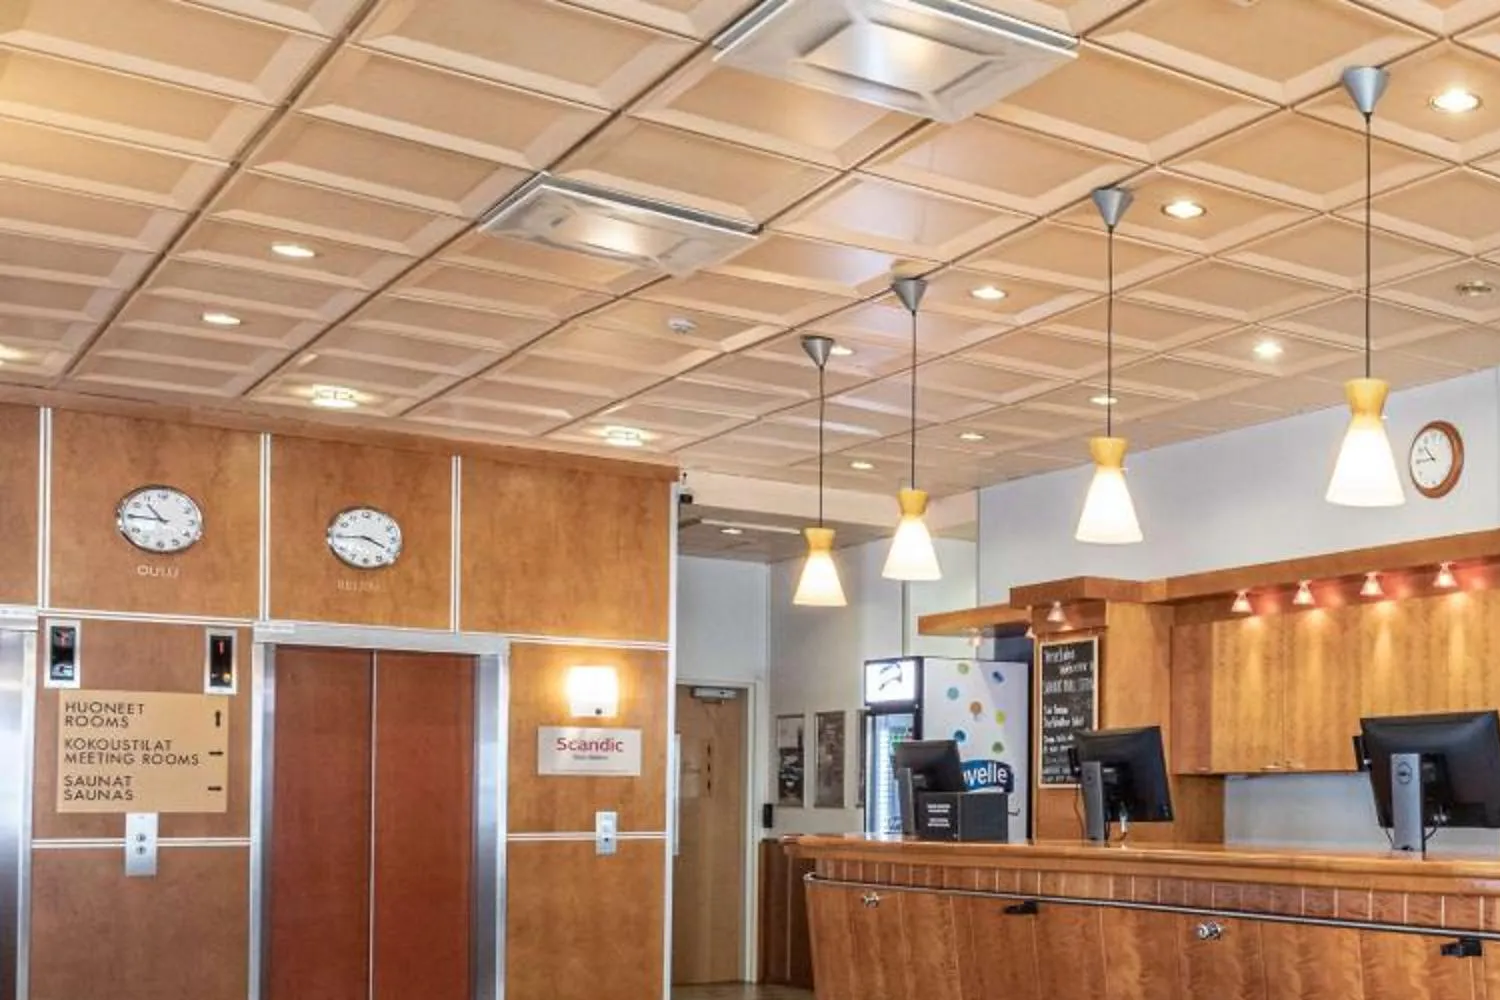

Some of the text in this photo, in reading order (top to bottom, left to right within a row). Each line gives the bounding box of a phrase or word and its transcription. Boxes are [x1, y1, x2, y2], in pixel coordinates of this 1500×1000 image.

[64, 701, 145, 715] HUONEET
[64, 715, 129, 728] ROOMS
[64, 737, 173, 750] KOKOUSTILAT
[556, 737, 624, 752] Scandic
[64, 752, 200, 766] MEETING ROOMS
[64, 775, 133, 787] SAUNAT
[64, 789, 134, 801] SAUNAS
